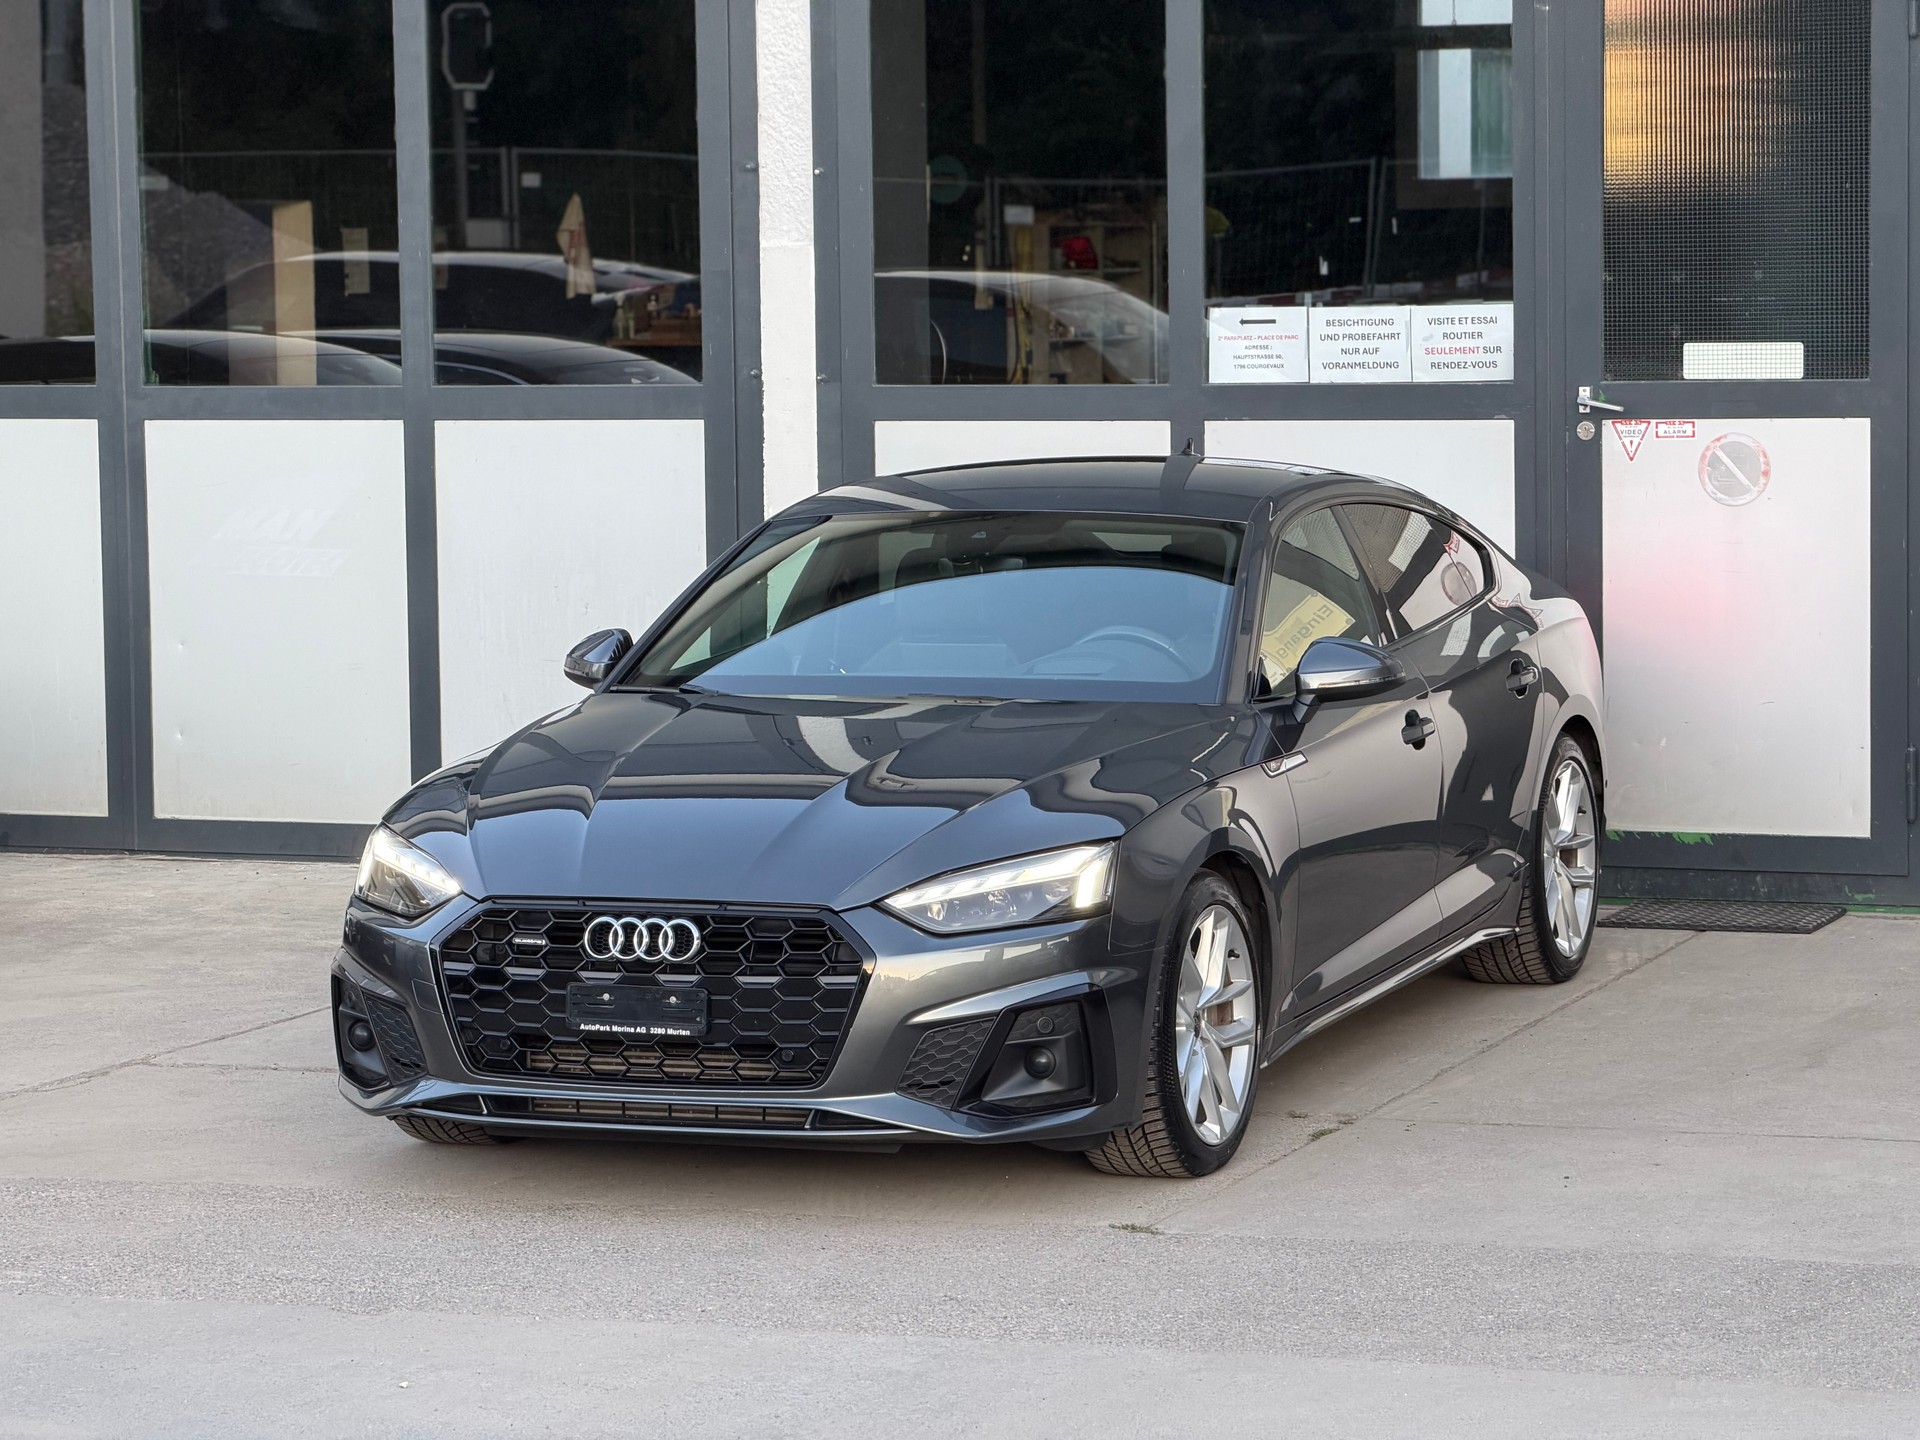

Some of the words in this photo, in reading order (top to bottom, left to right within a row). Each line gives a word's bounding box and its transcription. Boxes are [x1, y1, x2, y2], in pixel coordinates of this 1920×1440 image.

[1325, 318, 1395, 327] BESICHTIGUNG
[1427, 317, 1456, 326] VISITE
[1458, 317, 1469, 325] ET
[1471, 316, 1498, 325] ESSAI
[1320, 333, 1340, 342] UND
[1342, 332, 1401, 341] PROBEFAHRT
[1442, 331, 1483, 340] ROUTIER
[1340, 347, 1361, 356] NUR
[1362, 347, 1380, 355] AUF
[1424, 346, 1481, 356] SEULEMENT
[1482, 346, 1502, 354] SUR
[1321, 361, 1400, 370] VORANMELDUNG
[1430, 360, 1498, 370] RENDEZ-VOUS
[580, 1023, 611, 1031] AutoPark
[612, 1025, 635, 1033] Morina
